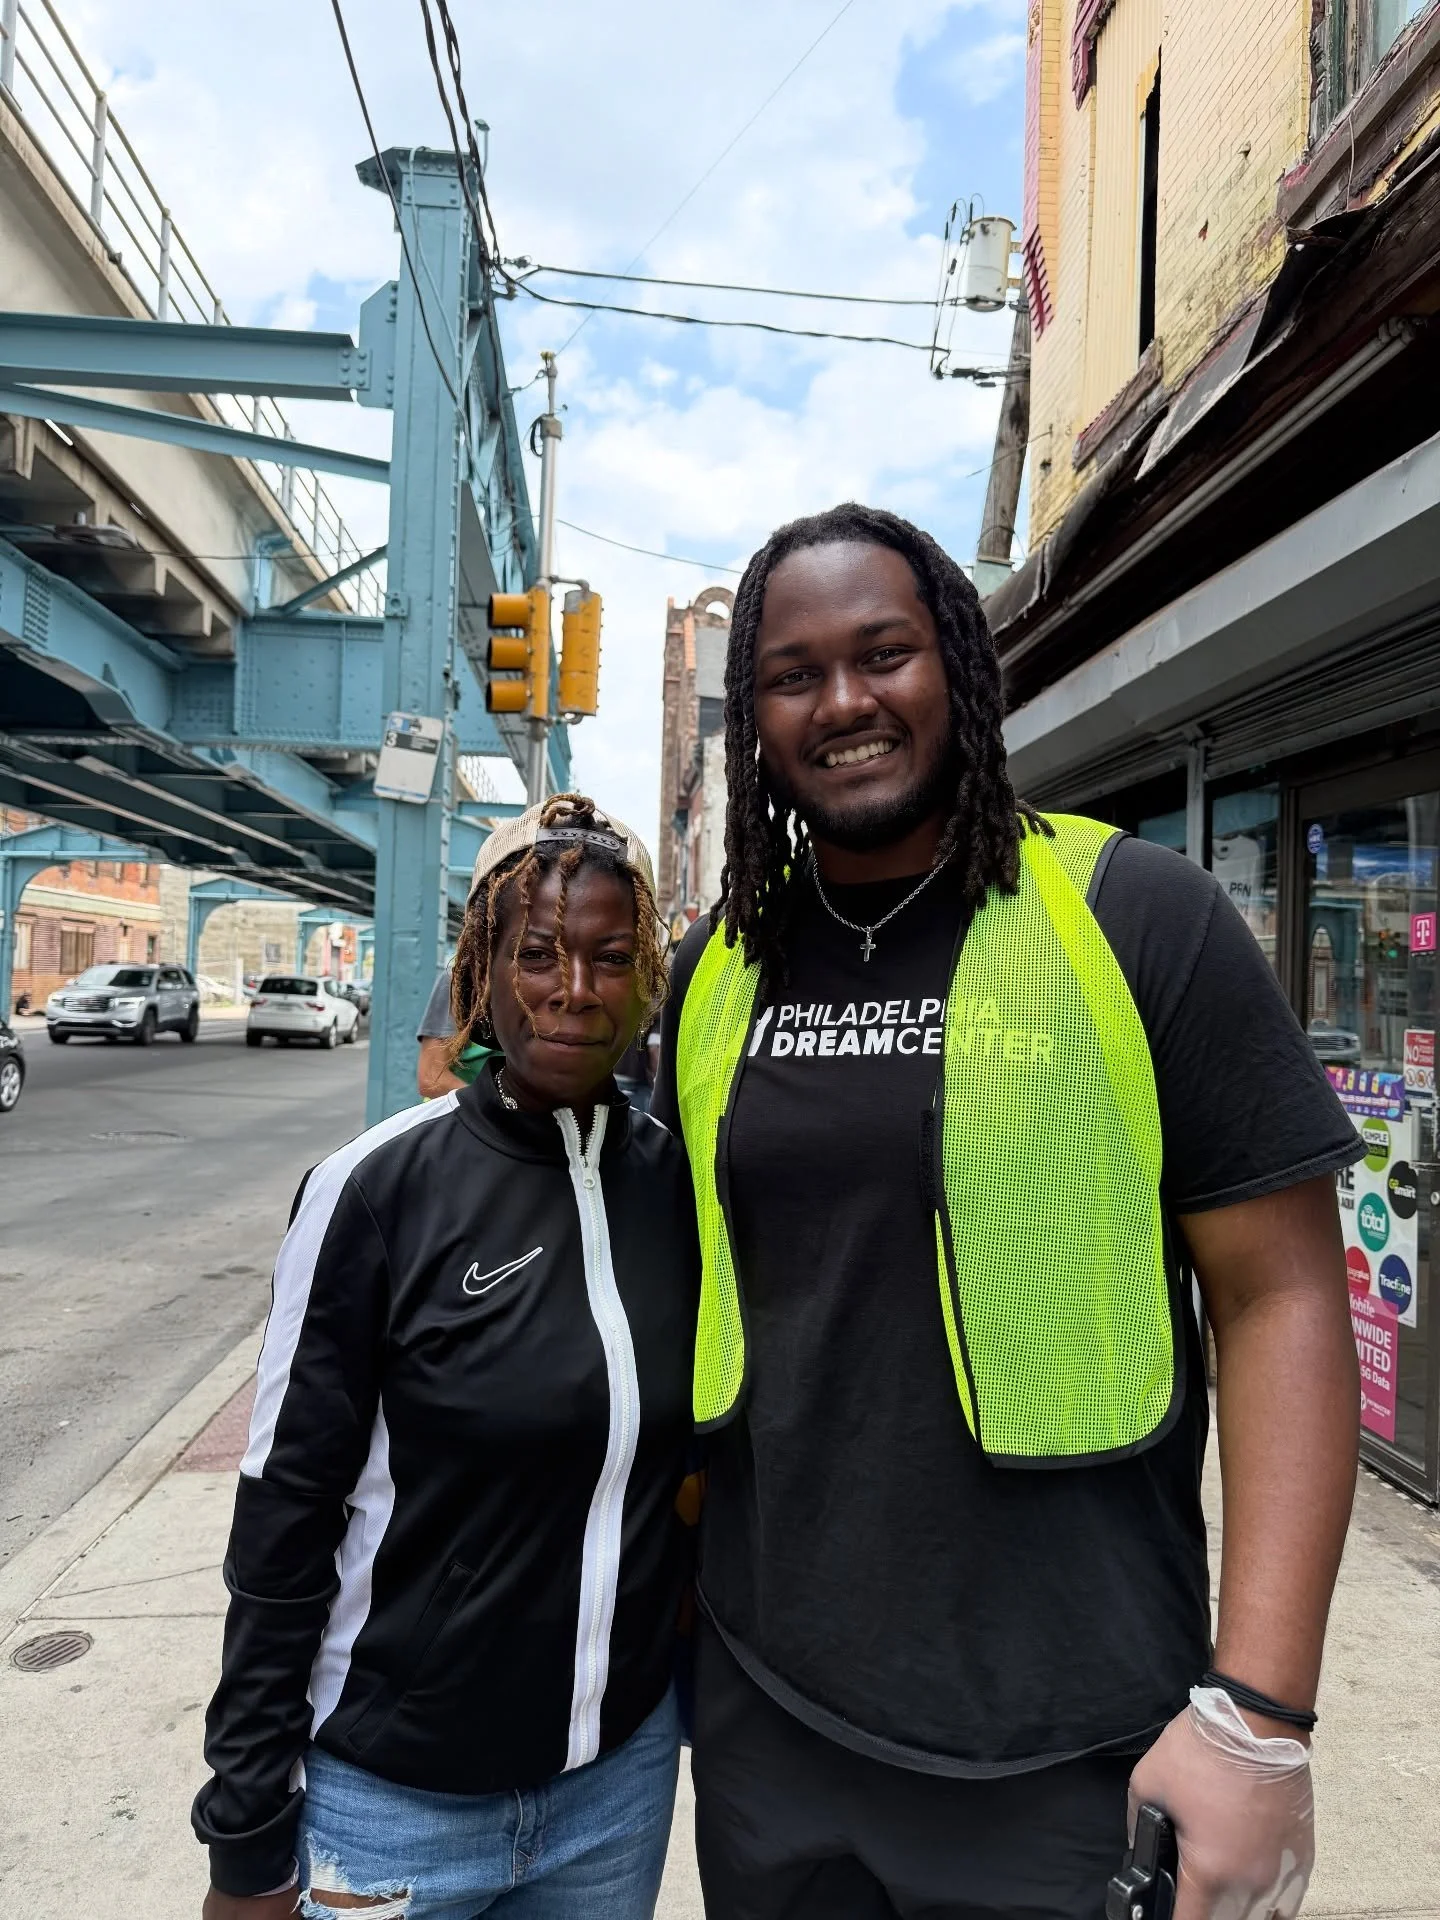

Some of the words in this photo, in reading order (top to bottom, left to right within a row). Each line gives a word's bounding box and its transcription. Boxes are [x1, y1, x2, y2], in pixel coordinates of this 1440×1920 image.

[385, 732, 398, 747] 3
[1405, 1044, 1419, 1062] NO
[1360, 1210, 1386, 1233] total
[1372, 1371, 1390, 1391] Data
